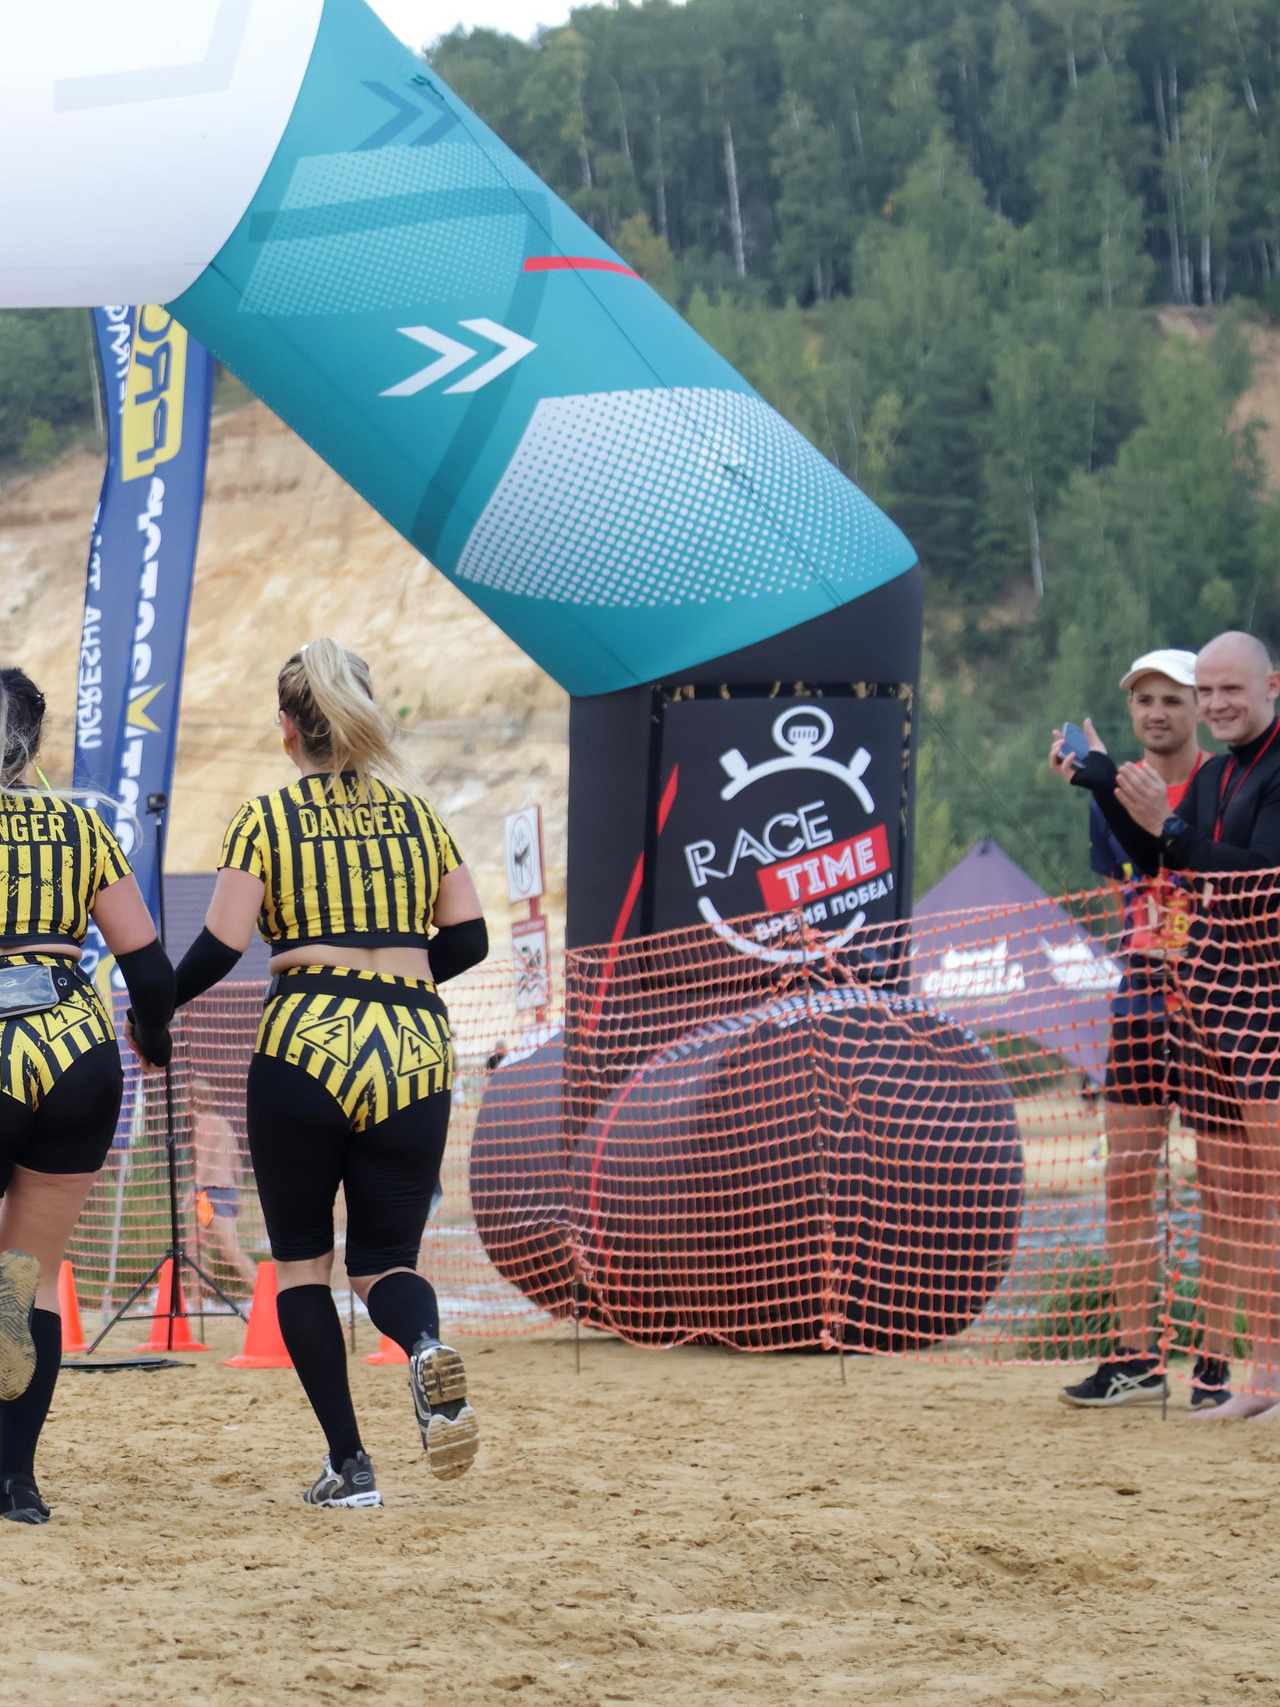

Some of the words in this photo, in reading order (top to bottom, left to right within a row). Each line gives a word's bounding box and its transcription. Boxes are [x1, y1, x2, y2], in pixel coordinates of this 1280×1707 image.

[298, 805, 410, 838] DANGER
[684, 799, 834, 888] RACE
[776, 836, 877, 901] TIME
